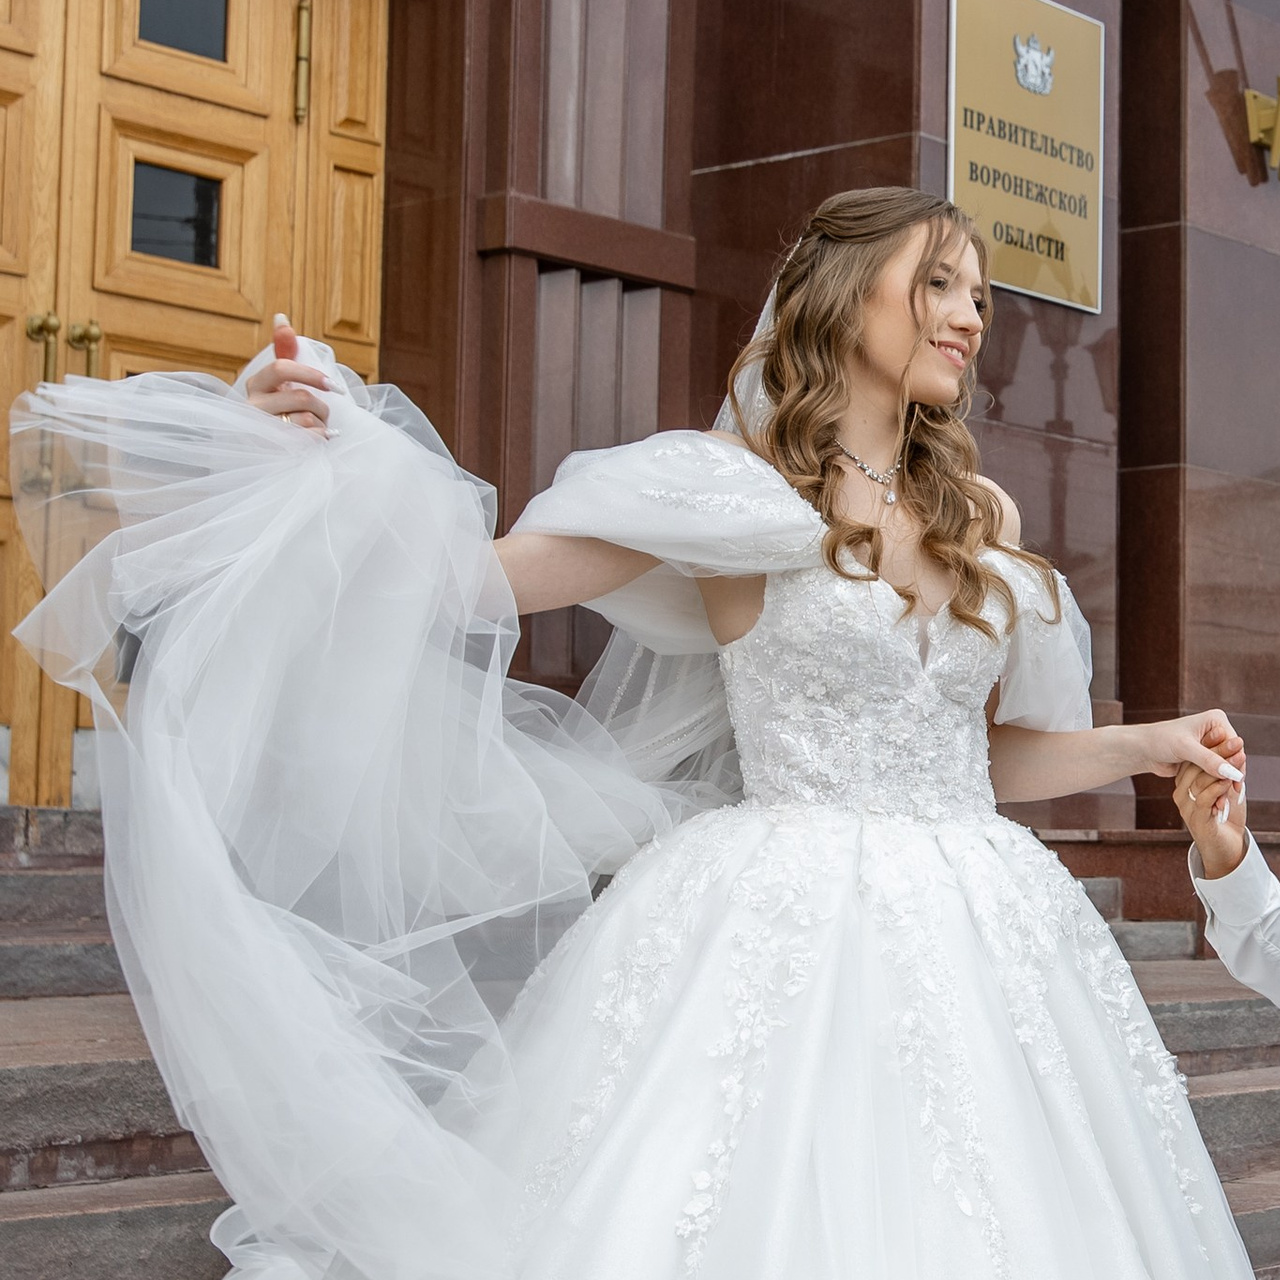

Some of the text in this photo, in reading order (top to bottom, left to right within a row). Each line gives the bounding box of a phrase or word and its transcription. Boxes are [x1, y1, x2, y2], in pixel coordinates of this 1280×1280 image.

[962, 107, 1095, 173] ПРАВИТЕЛЬСТВО
[969, 161, 1088, 219] ВОРОНЕЖСКОЙ
[993, 221, 1066, 262] ОБЛАСТИ
